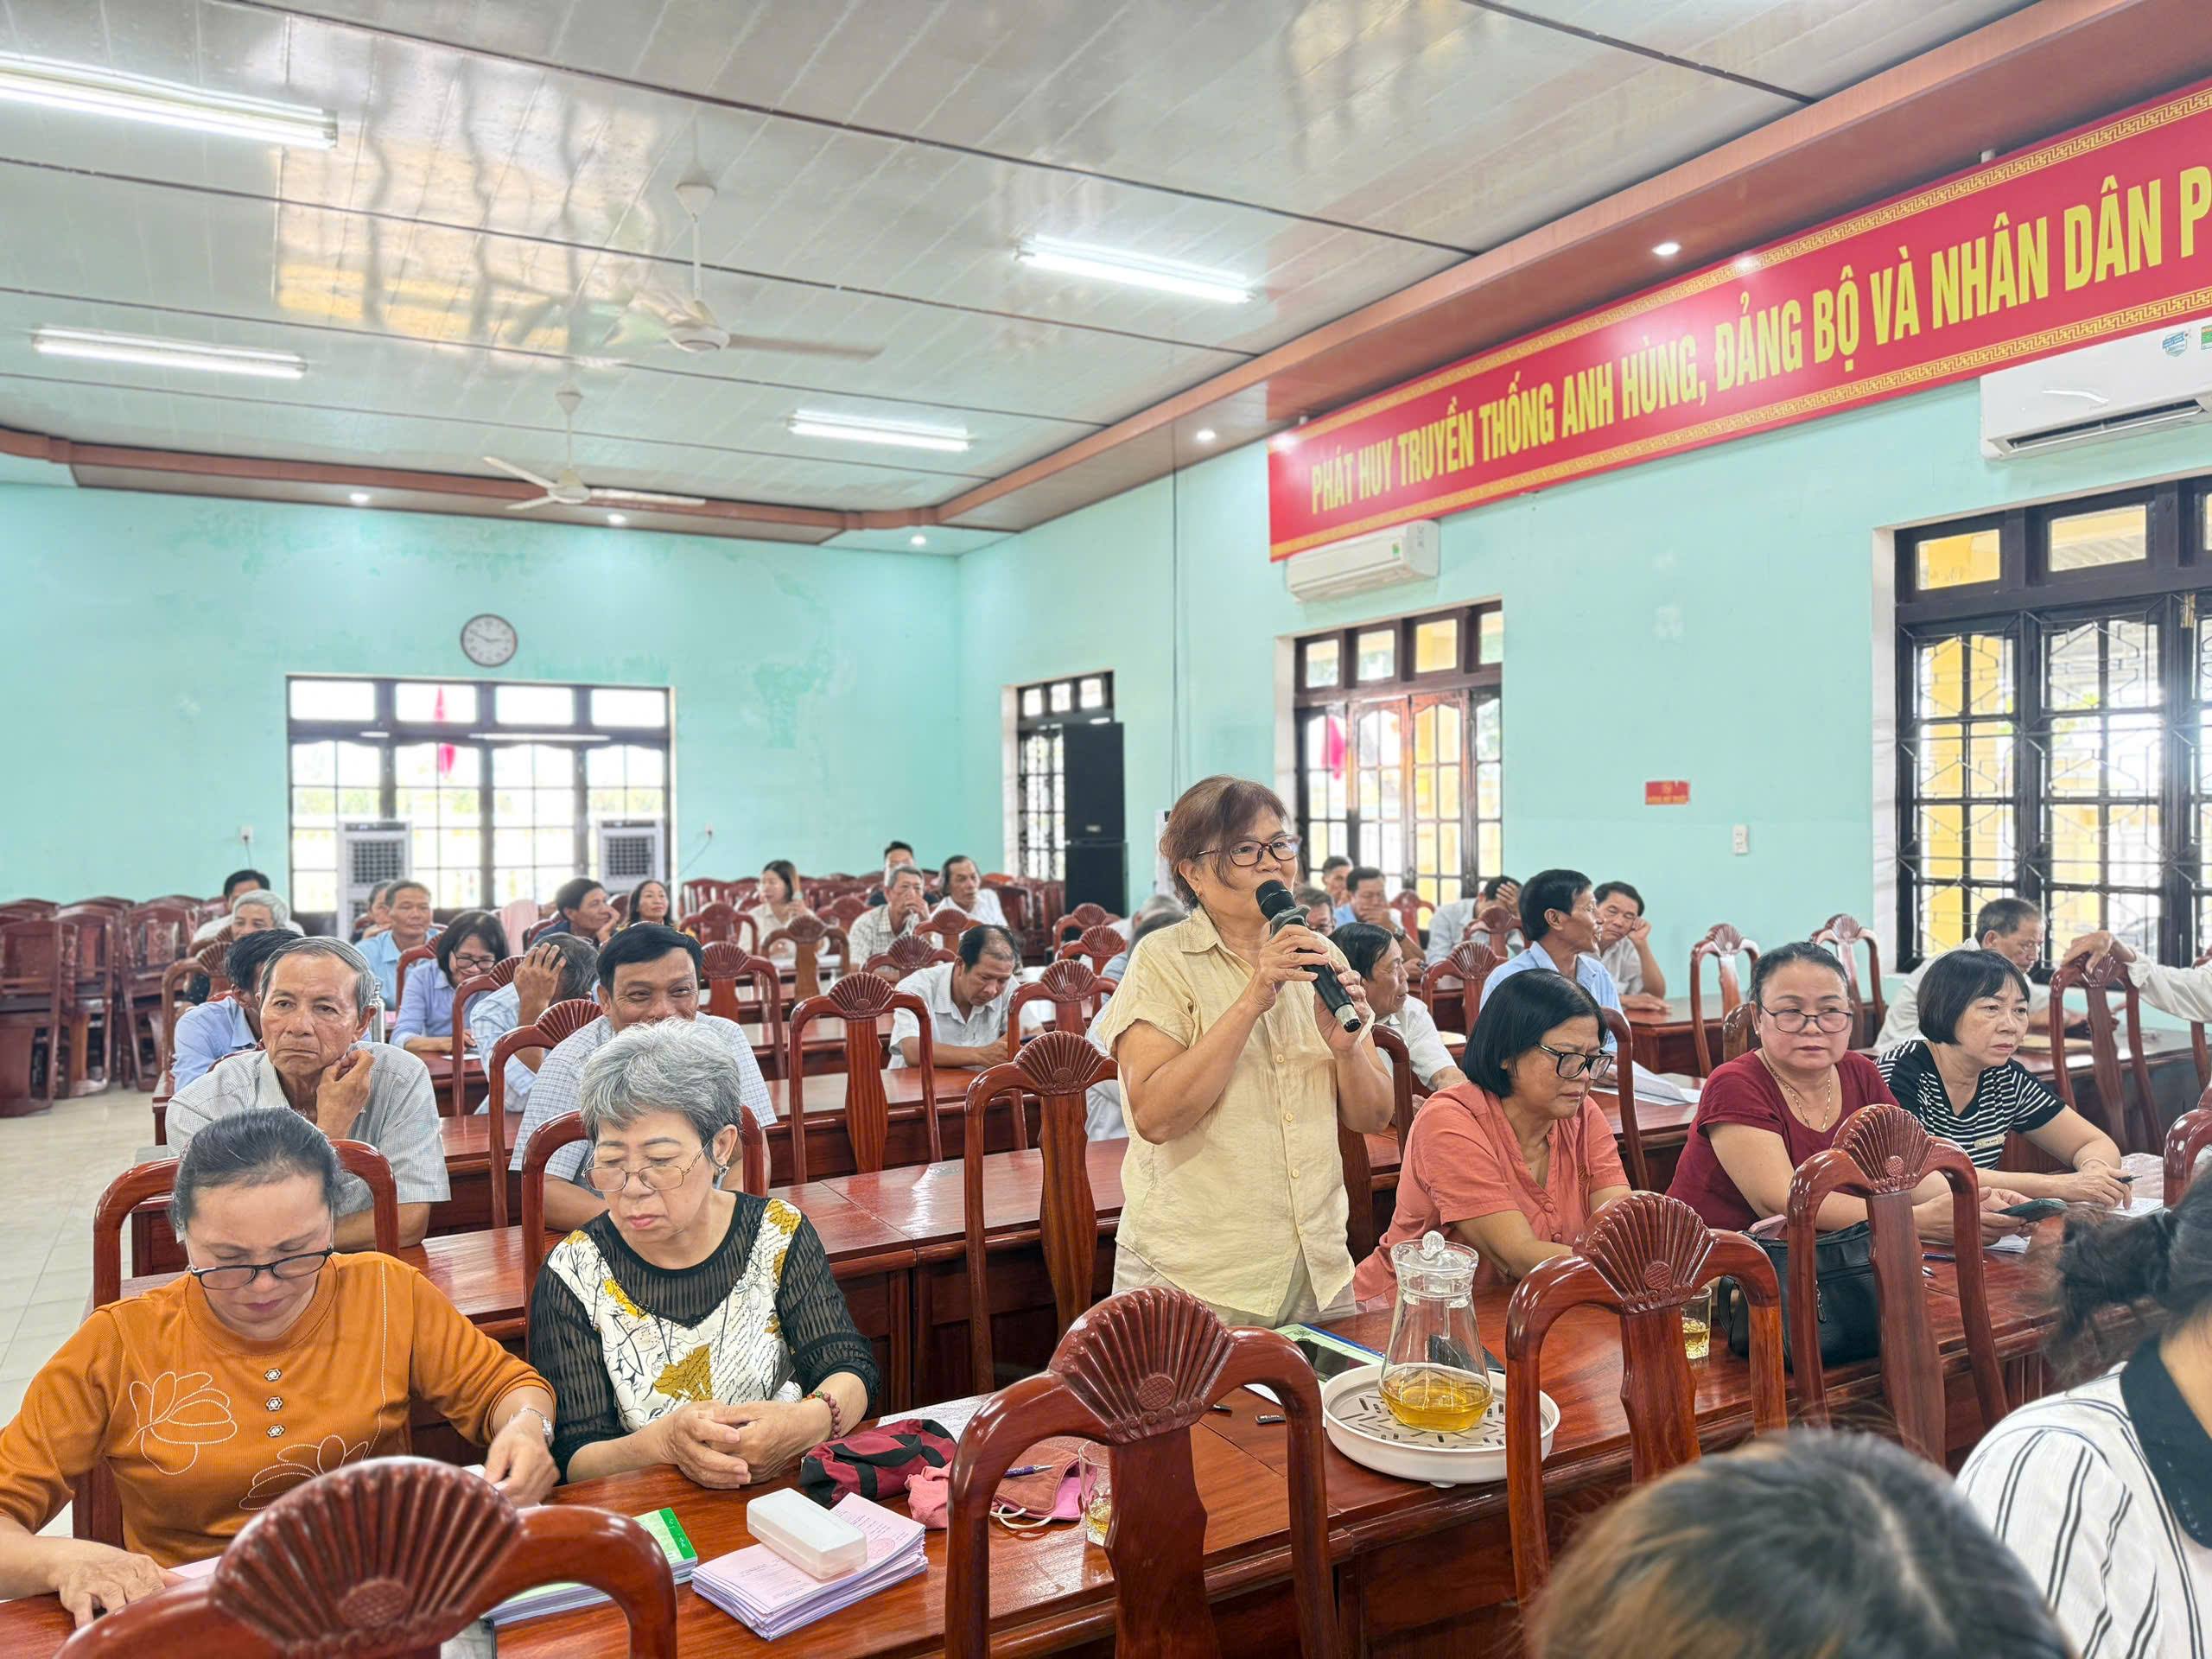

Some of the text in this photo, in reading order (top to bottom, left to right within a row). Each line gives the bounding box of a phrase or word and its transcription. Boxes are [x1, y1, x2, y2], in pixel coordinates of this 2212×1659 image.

[1312, 442, 1353, 514] PHÁT
[1357, 436, 1393, 501] HUY
[1398, 397, 1474, 486] TRUYỀN
[1479, 372, 1554, 462] THỐNG
[1561, 362, 1614, 439] ANH
[1622, 333, 1707, 420] HÙNG,
[1715, 290, 1802, 392] ĐẢNG
[1813, 264, 1859, 372] BỘ
[1870, 245, 1920, 346] VÀ
[1931, 211, 2049, 329] NHÂN
[2063, 175, 2162, 291] DÂN
